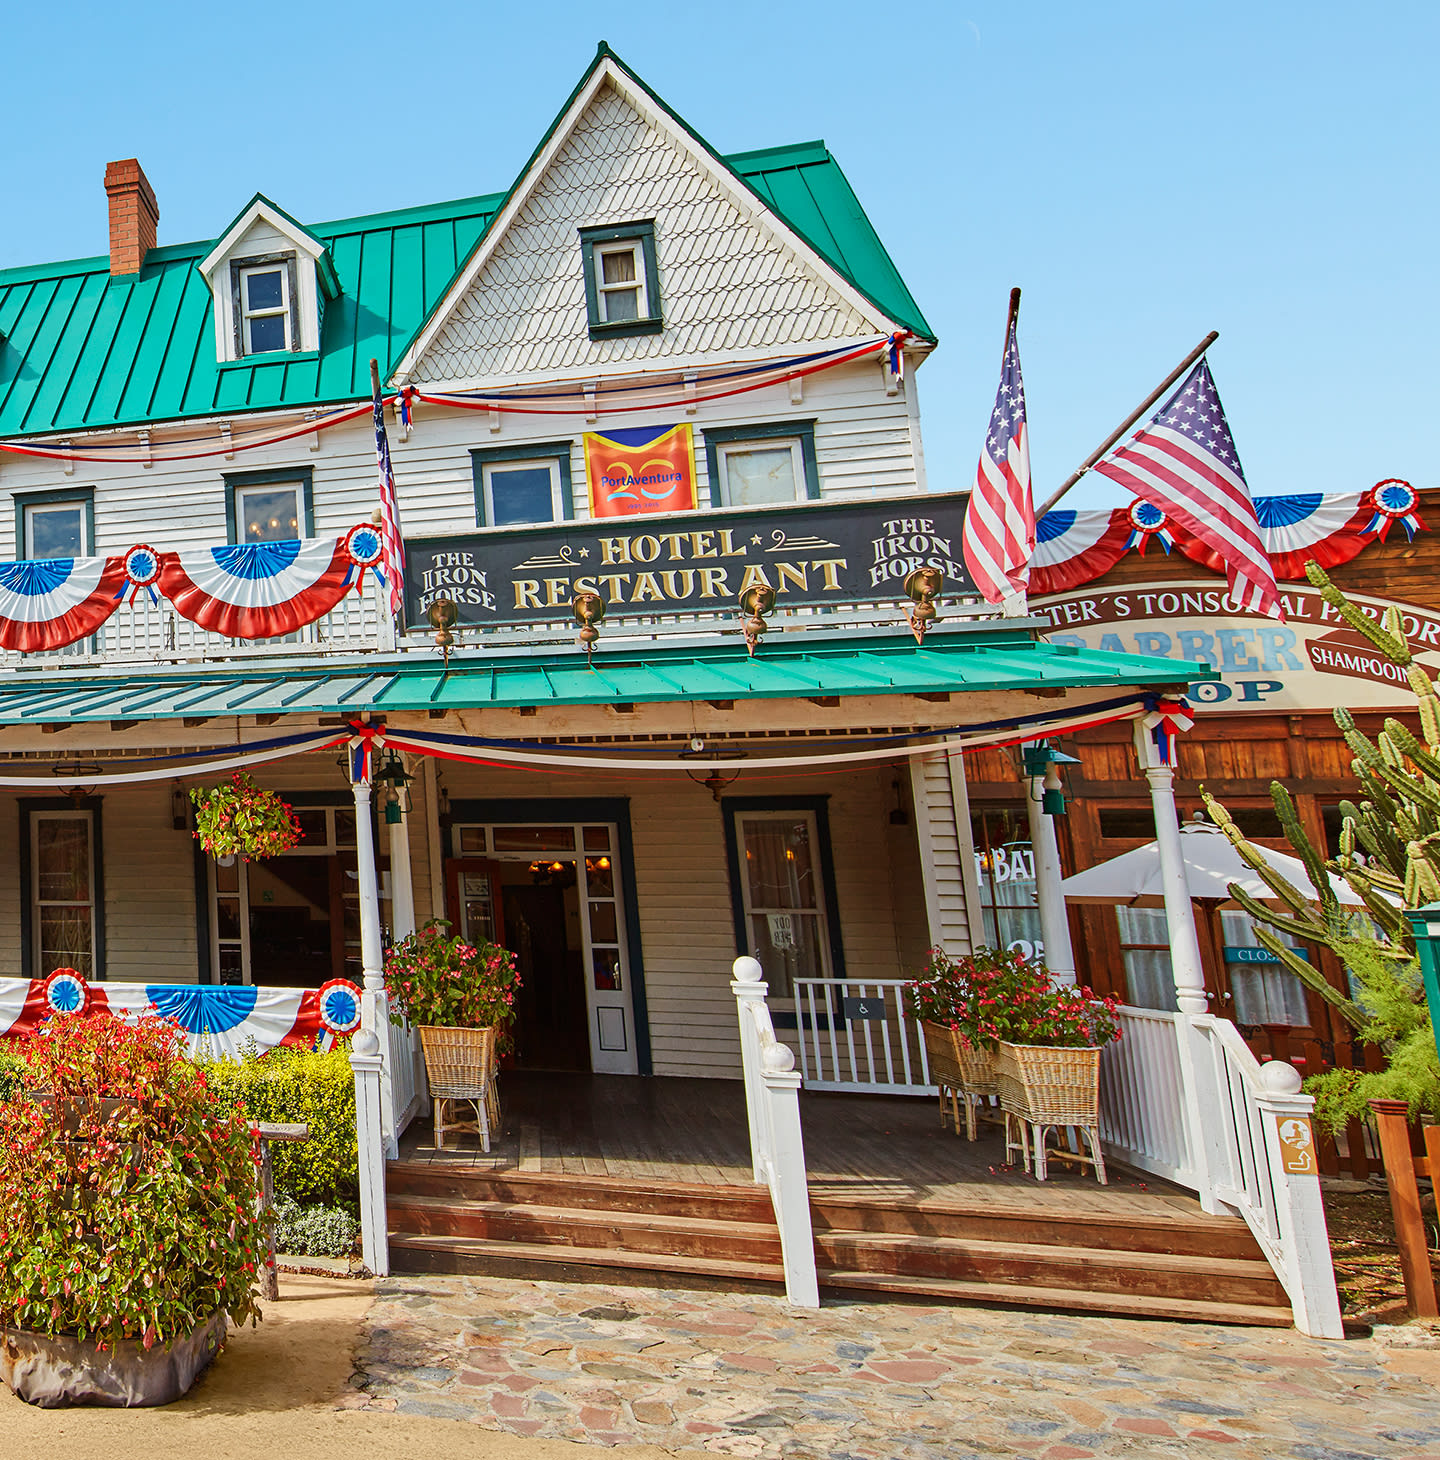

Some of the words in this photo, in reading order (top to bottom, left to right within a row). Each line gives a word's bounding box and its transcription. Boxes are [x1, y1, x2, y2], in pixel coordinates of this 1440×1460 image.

[601, 472, 682, 487] PortAventura
[883, 518, 935, 536] THE
[431, 552, 474, 568] THE
[598, 529, 747, 565] HOTEL
[872, 534, 951, 564] IRON
[422, 567, 487, 593] IRON
[512, 559, 847, 609] RESTAURANT
[868, 556, 964, 588] HORSE
[419, 586, 496, 615] HORSE
[1137, 591, 1311, 618] TONSOAL
[1320, 601, 1440, 645] PLOR
